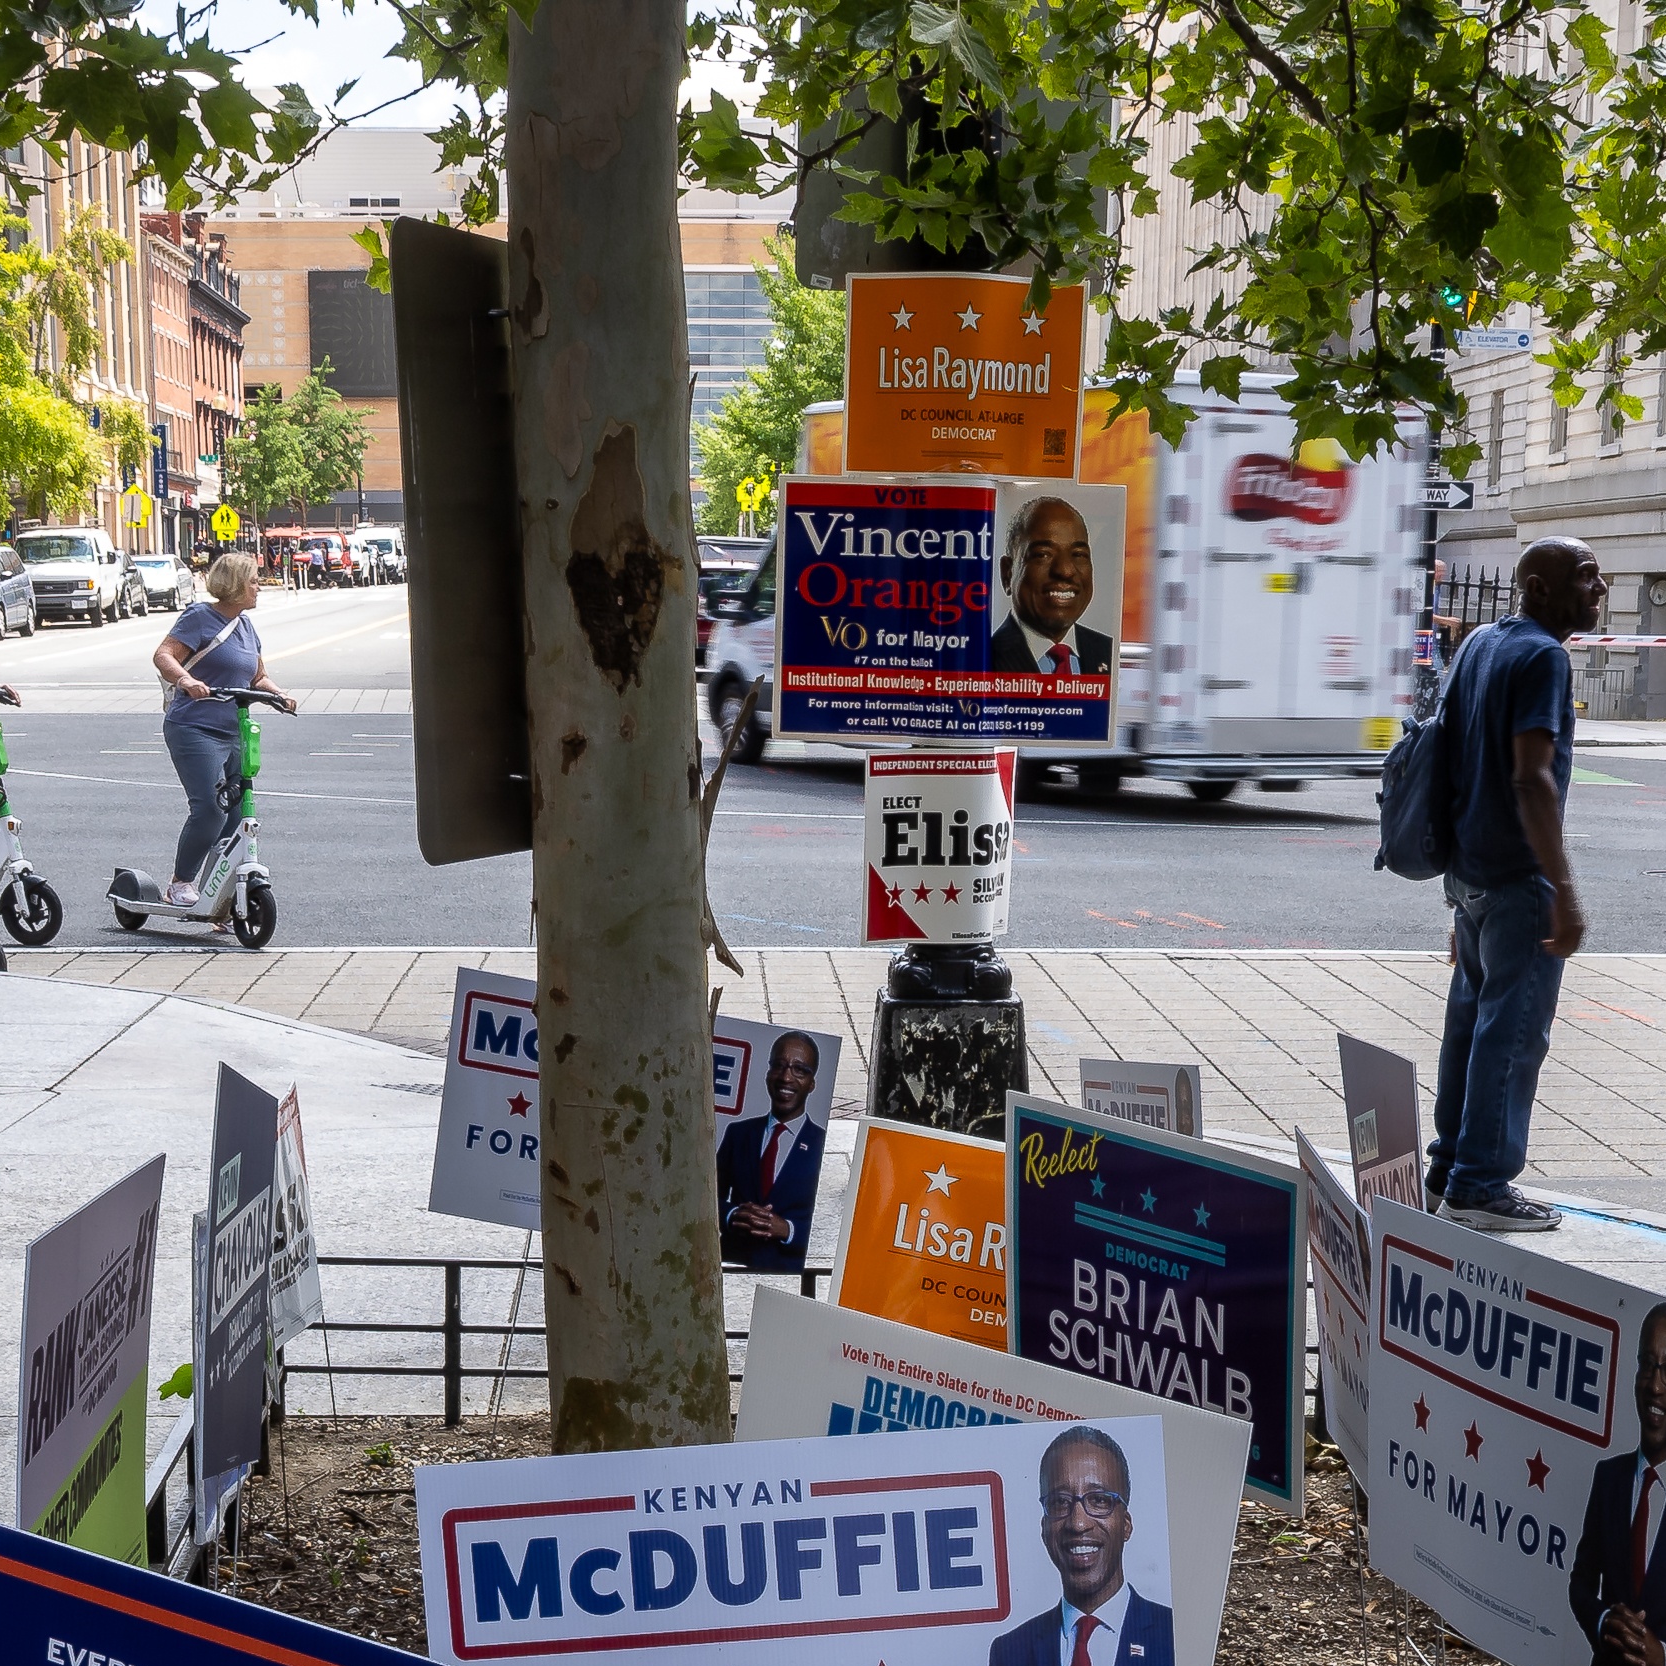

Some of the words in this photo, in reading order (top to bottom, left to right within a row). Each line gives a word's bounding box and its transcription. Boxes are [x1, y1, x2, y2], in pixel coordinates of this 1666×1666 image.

[1477, 335, 1509, 344] ELEVATOR
[878, 346, 929, 389] Lisa
[933, 346, 1052, 400] Raymond
[900, 408, 917, 421] DC
[920, 409, 974, 423] COUNCIL
[931, 426, 998, 441] DEMOCRAT
[874, 487, 927, 506] VOTE
[1426, 489, 1450, 501] WAY
[794, 511, 992, 561] Vincent
[797, 562, 989, 626] Orange
[876, 628, 908, 647] for
[913, 630, 970, 652] Mayor
[871, 657, 886, 666] on
[889, 656, 908, 666] the
[787, 671, 864, 688] Institutional
[866, 673, 925, 693] Knowledge
[1056, 678, 1105, 699] Delivery
[808, 697, 828, 708] For
[831, 700, 862, 709] more
[864, 699, 925, 712] information
[925, 702, 955, 714] visit:
[846, 718, 859, 726] or
[909, 718, 943, 729] GRACE
[962, 722, 976, 730] on
[873, 760, 936, 771] INDEPENDENT
[936, 760, 977, 770] SPECIAL
[882, 795, 923, 810] ELECT
[204, 859, 231, 898] Lime
[1019, 1126, 1105, 1190] Reelect
[892, 1201, 974, 1269] Lisa
[214, 1198, 268, 1316] CHAVOUS
[1105, 1241, 1191, 1282] DEMOCRAT
[920, 1276, 949, 1296] DC
[1454, 1256, 1525, 1303] KENYAN
[1073, 1257, 1226, 1358] BRIAN
[1389, 1261, 1606, 1417] McDUFFIE
[24, 1300, 82, 1469] RANK
[840, 1341, 870, 1366] Vote
[871, 1350, 896, 1373] The
[897, 1358, 934, 1385] Entire
[935, 1369, 968, 1395] Slate
[970, 1378, 990, 1400] for
[992, 1384, 1014, 1407] the
[1015, 1394, 1034, 1414] DC
[1048, 1308, 1255, 1422] SCHWALB
[642, 1477, 804, 1515] KENYAN
[1386, 1437, 1437, 1504] FOR
[1445, 1473, 1570, 1573] MAYOR
[469, 1506, 985, 1624] McDUFFIE
